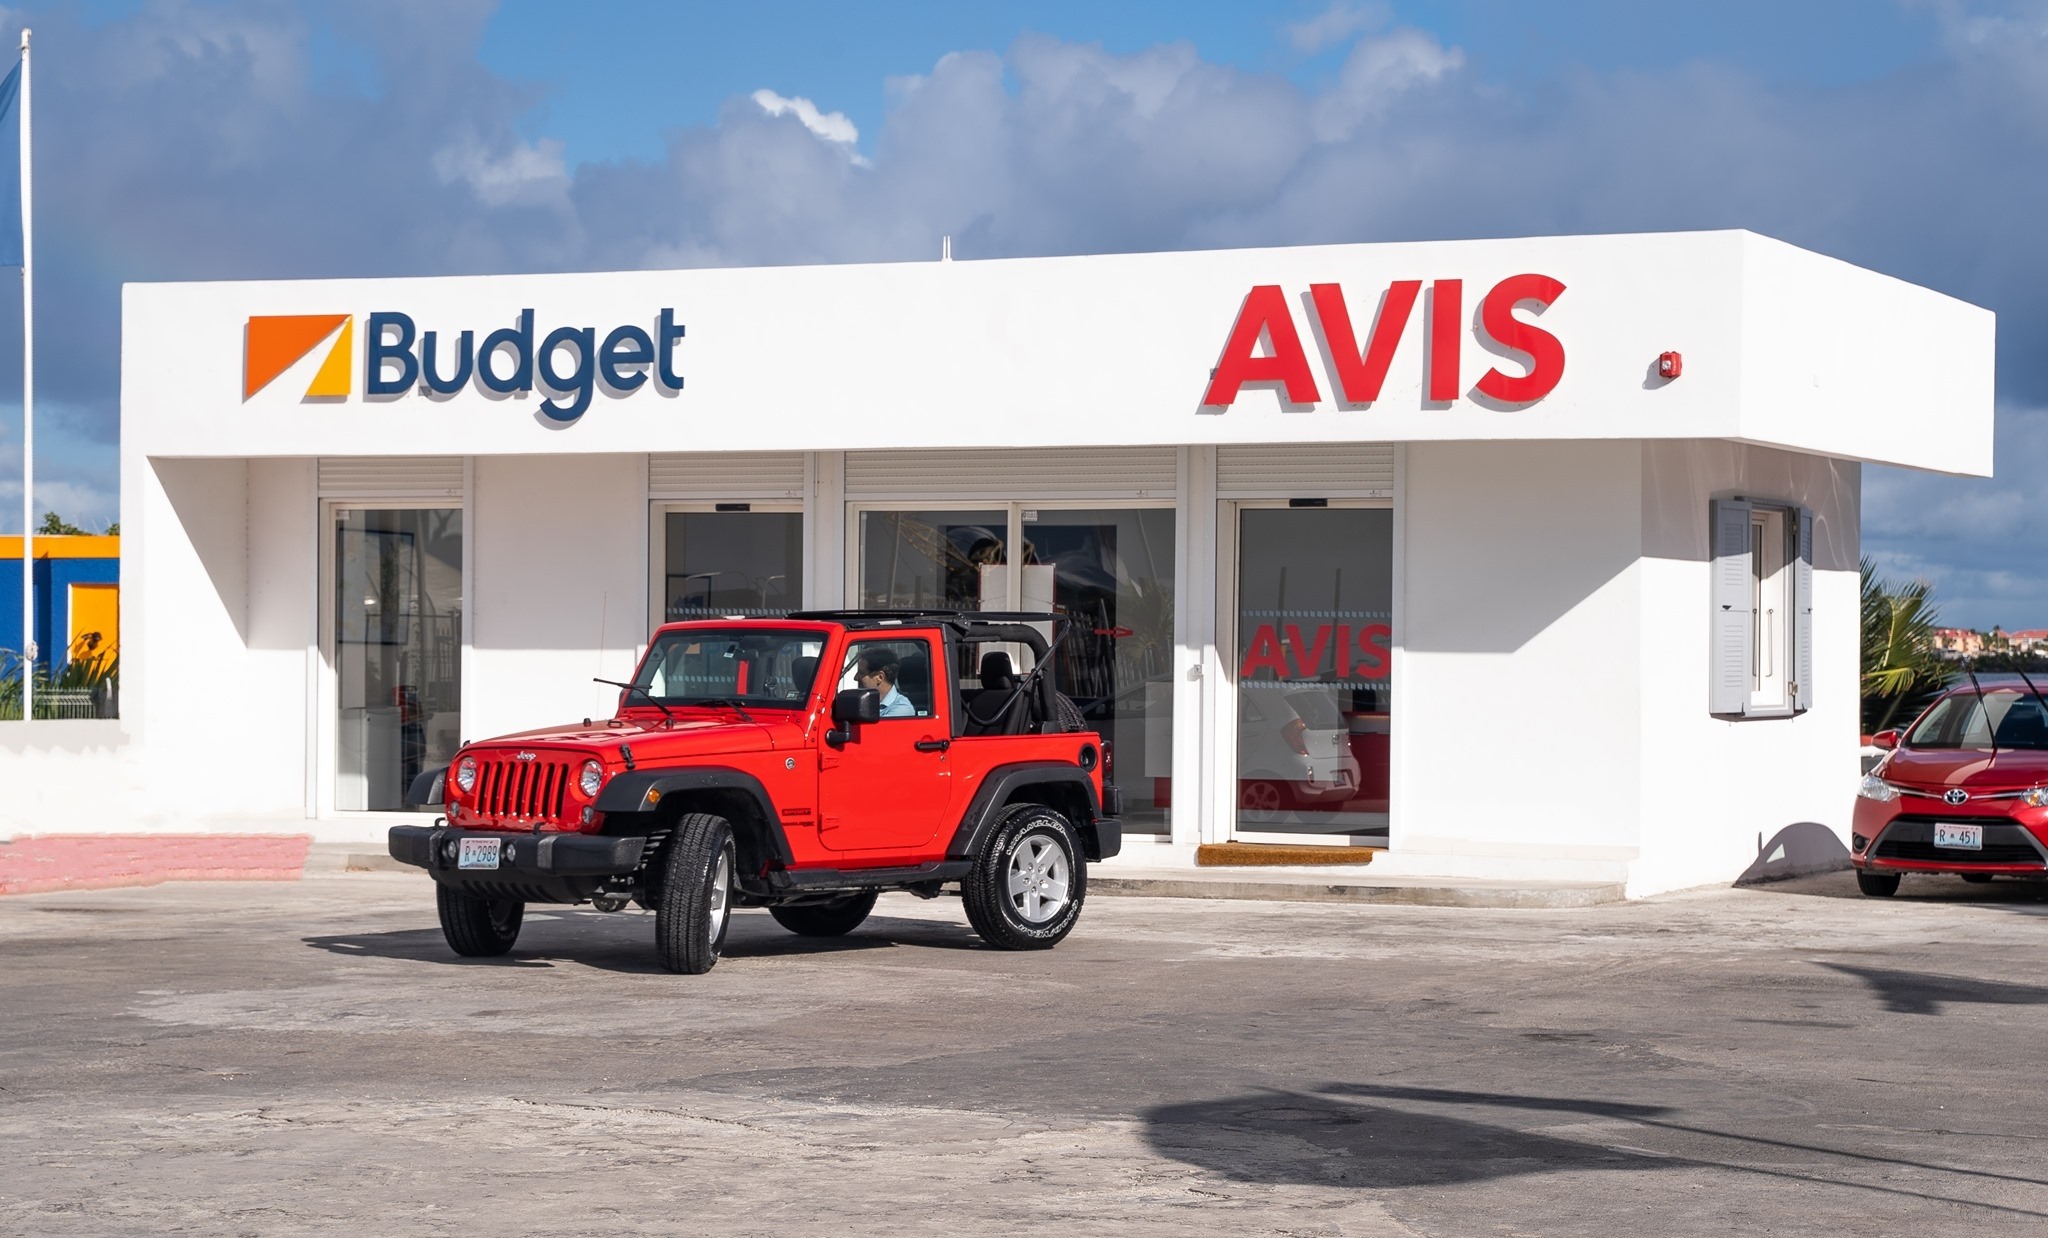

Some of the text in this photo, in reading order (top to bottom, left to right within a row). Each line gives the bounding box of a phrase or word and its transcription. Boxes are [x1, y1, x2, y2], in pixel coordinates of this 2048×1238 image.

[1203, 273, 1566, 406] AVIS
[367, 308, 686, 421] Budget
[1240, 623, 1392, 679] AVIS
[517, 751, 536, 761] Jeep
[476, 845, 498, 862] 2989
[1939, 829, 1976, 845] R 451
